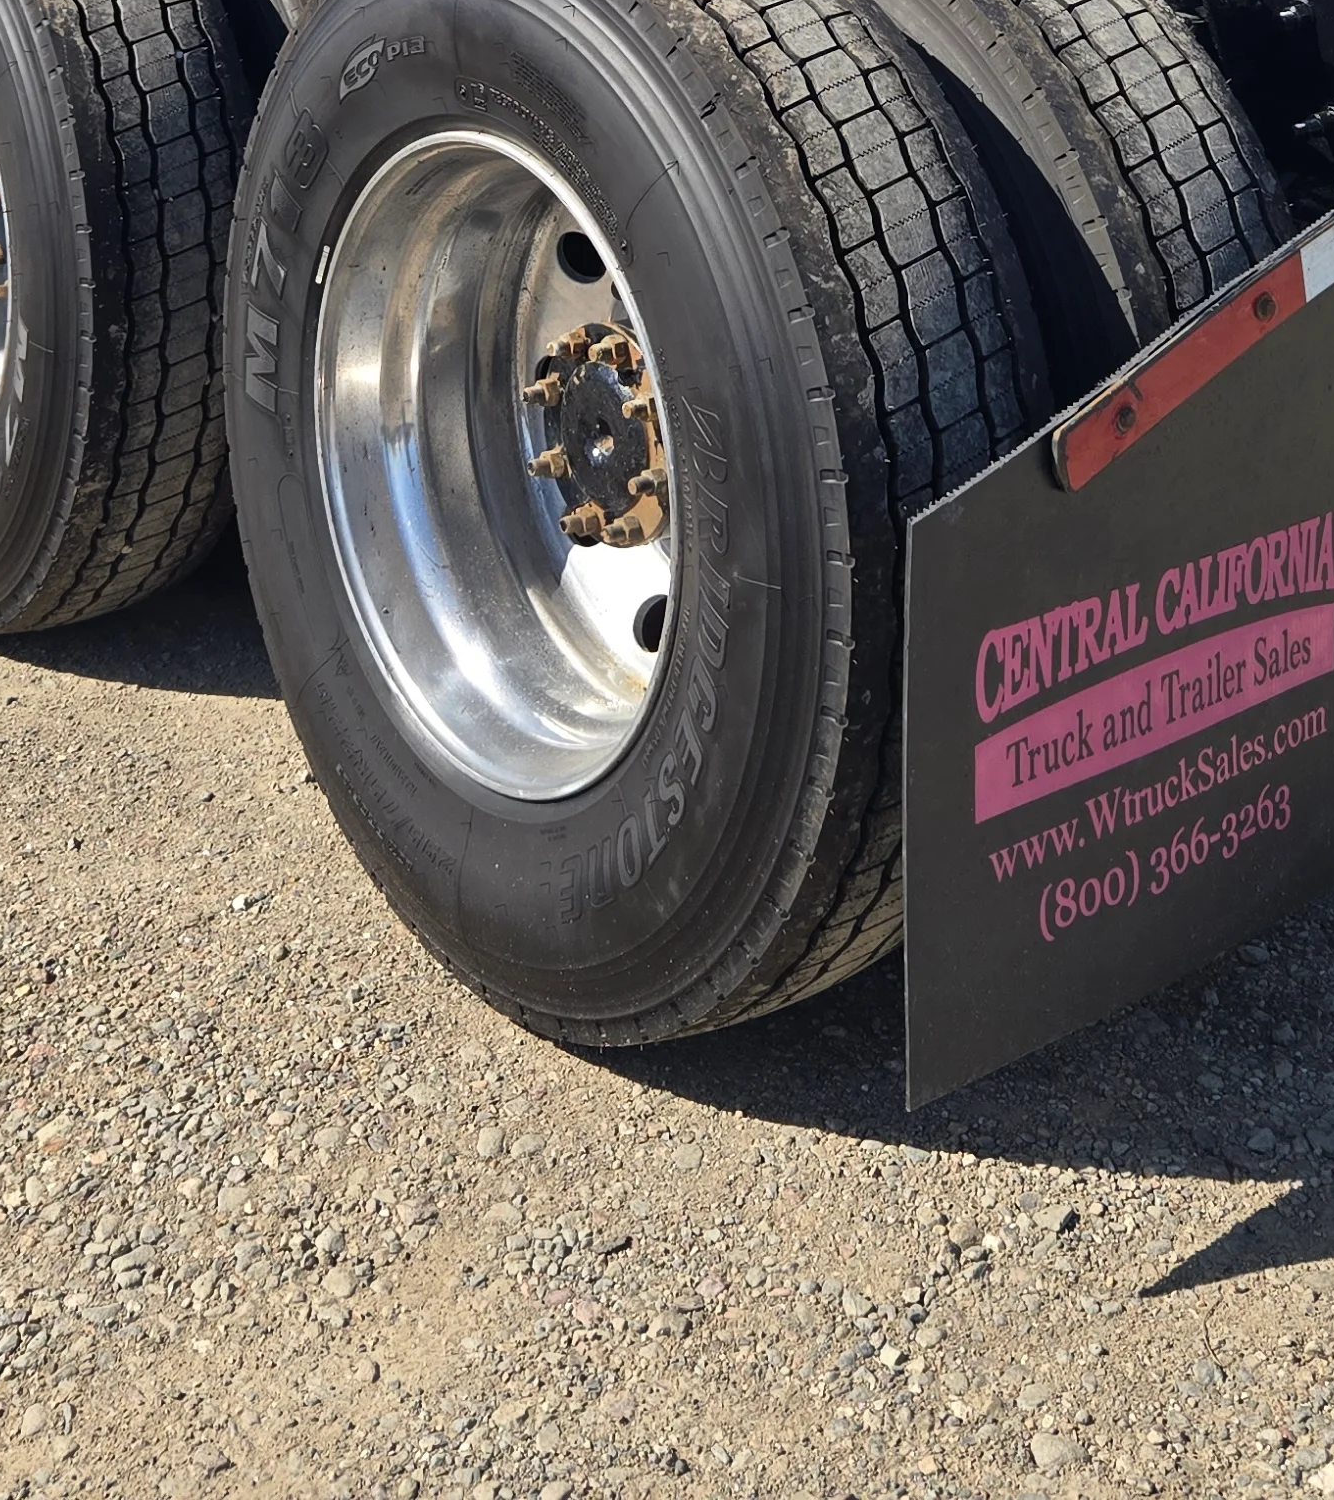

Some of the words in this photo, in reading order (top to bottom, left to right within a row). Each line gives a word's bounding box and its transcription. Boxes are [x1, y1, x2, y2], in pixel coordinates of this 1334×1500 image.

[243, 106, 330, 417] M713
[559, 396, 731, 927] BRIDGESTONE
[974, 581, 1149, 725] CENTRAL
[1006, 724, 1093, 788] Truck
[1103, 681, 1152, 752] and
[1160, 651, 1247, 729] Trailer
[1253, 630, 1312, 689] Sales
[988, 703, 1328, 884] www.WtruckSales.com
[1038, 850, 1141, 943] (800)
[1150, 784, 1293, 896] 366-3263
